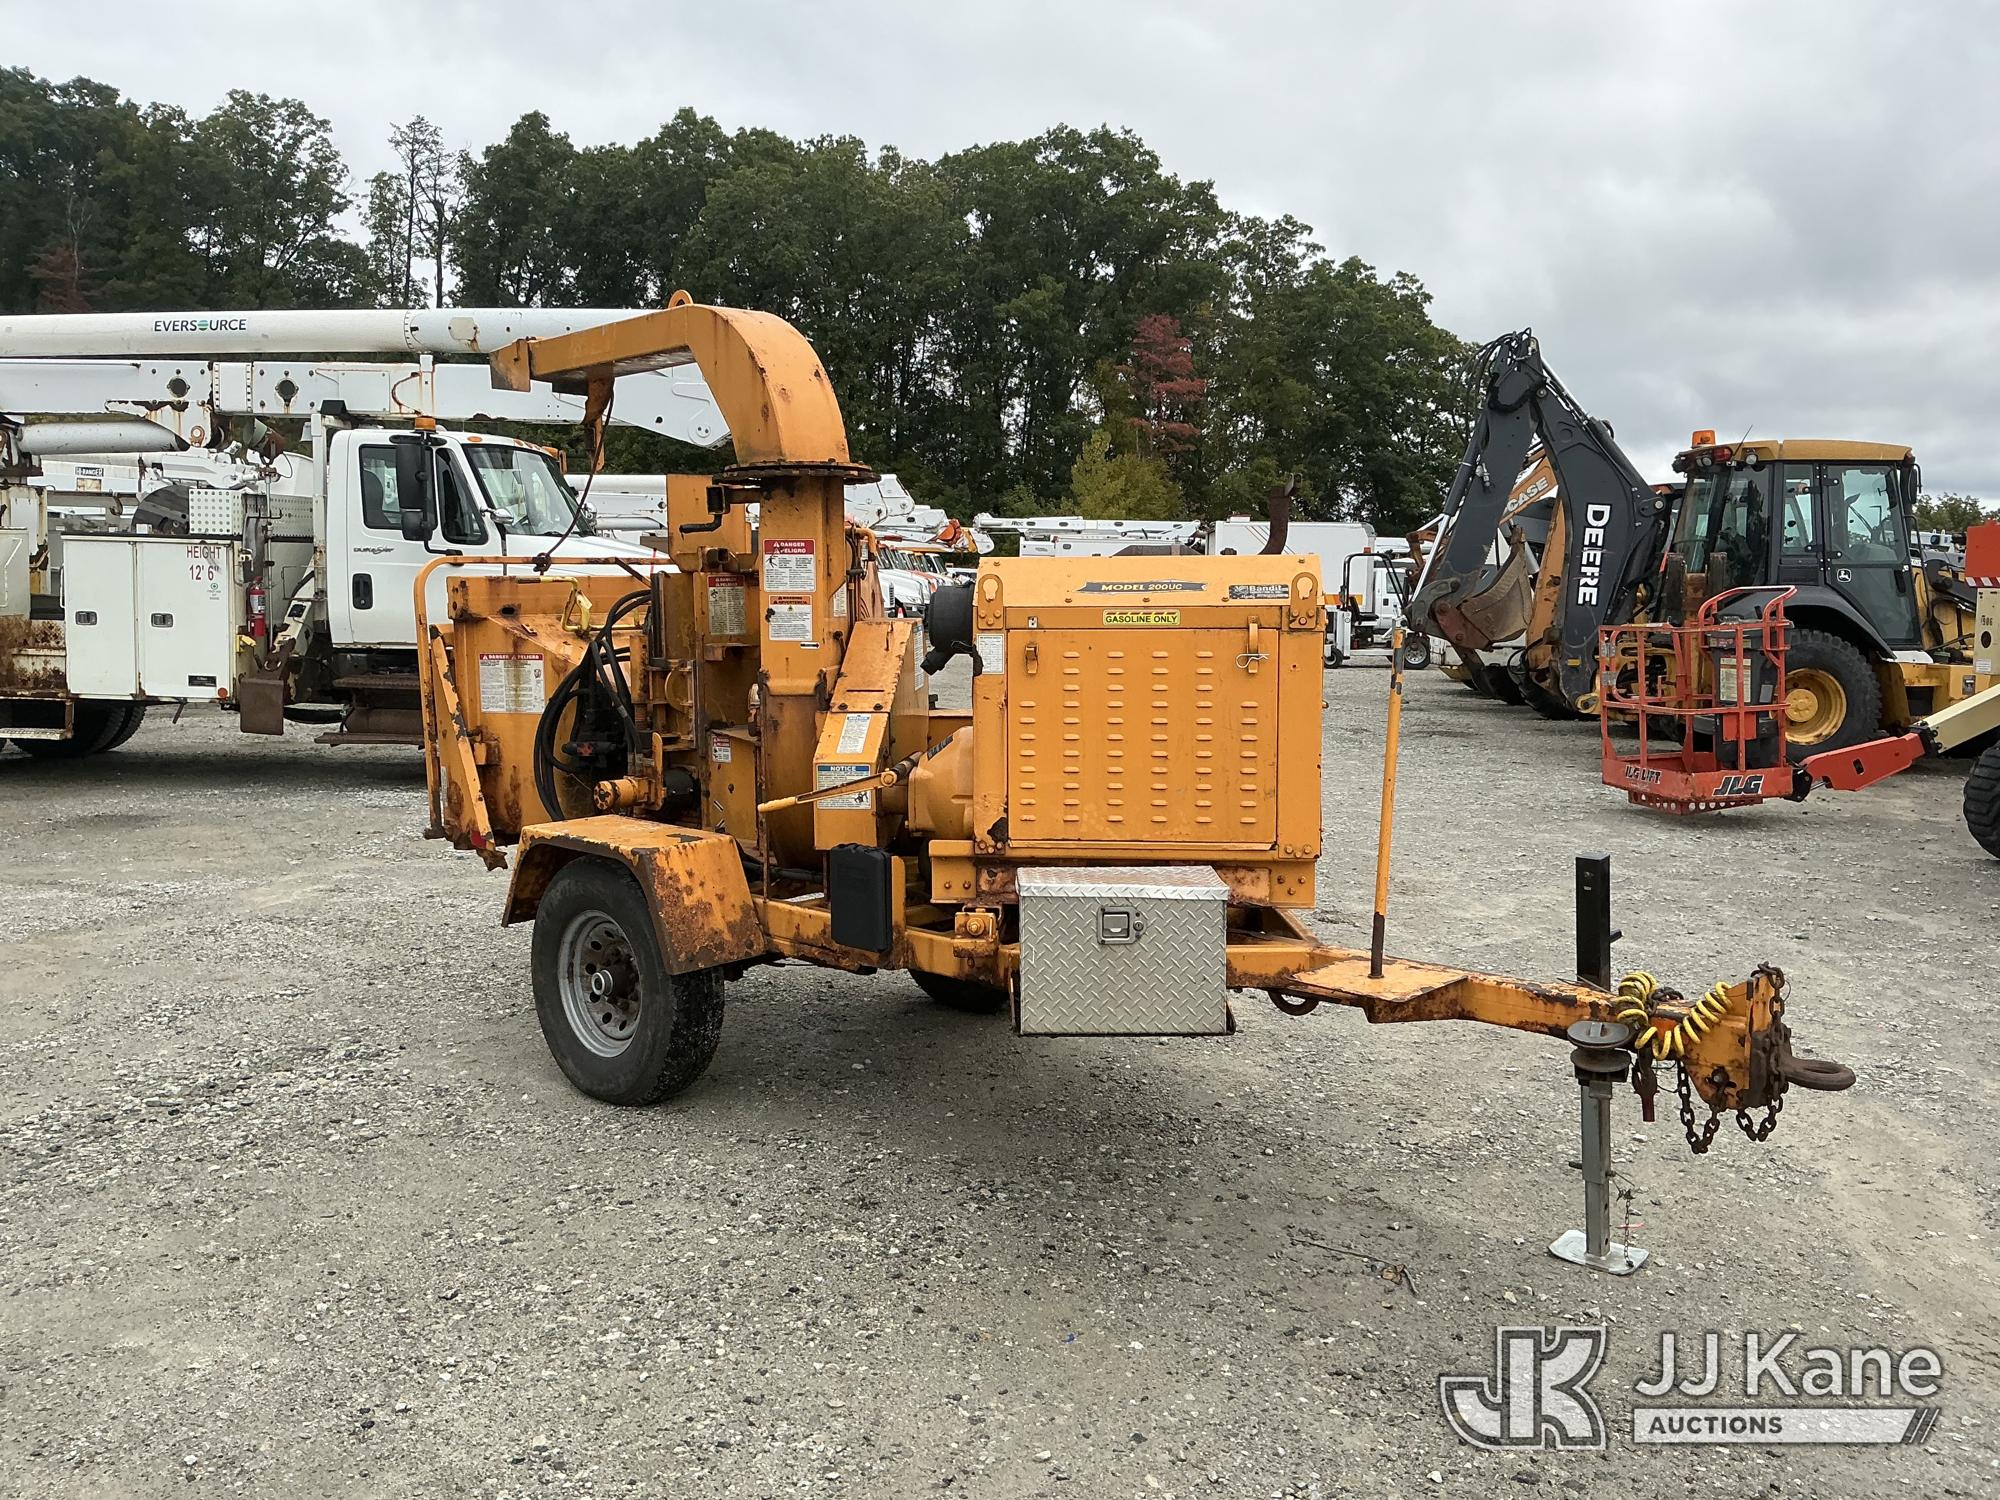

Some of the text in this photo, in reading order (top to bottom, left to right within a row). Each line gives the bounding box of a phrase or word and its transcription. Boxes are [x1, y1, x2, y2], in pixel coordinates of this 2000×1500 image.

[154, 319, 247, 331] EVERSOURCE
[1507, 477, 1549, 512] CASE
[186, 546, 222, 559] HEIGHT
[1577, 503, 1612, 606] DEERE
[189, 564, 205, 581] 12'
[1147, 583, 1183, 591] 200UC
[1105, 615, 1178, 623] GASOLINE ONLY
[1712, 774, 1764, 796] JLG
